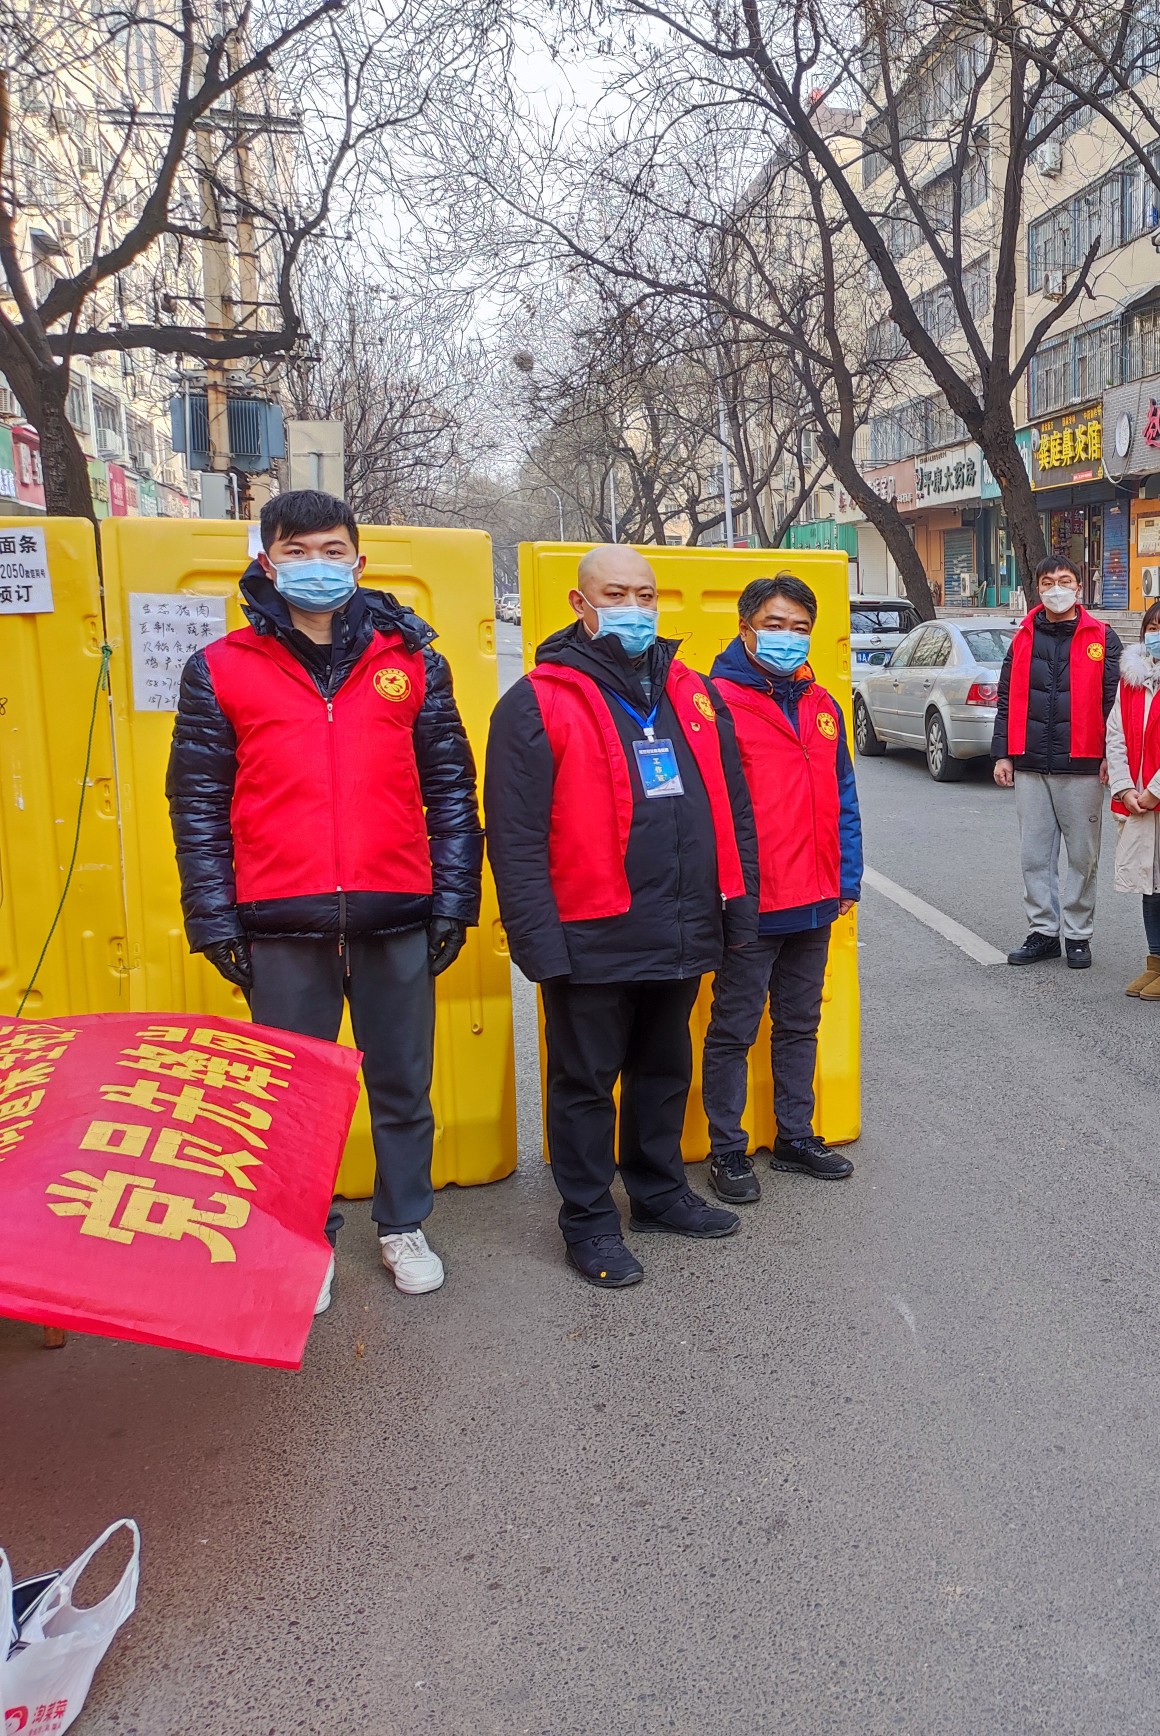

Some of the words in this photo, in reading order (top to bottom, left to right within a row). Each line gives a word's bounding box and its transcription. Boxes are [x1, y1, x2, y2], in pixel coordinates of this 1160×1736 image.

[0, 535, 37, 554] 面条
[44, 1025, 297, 1264] 党员先锋岗
